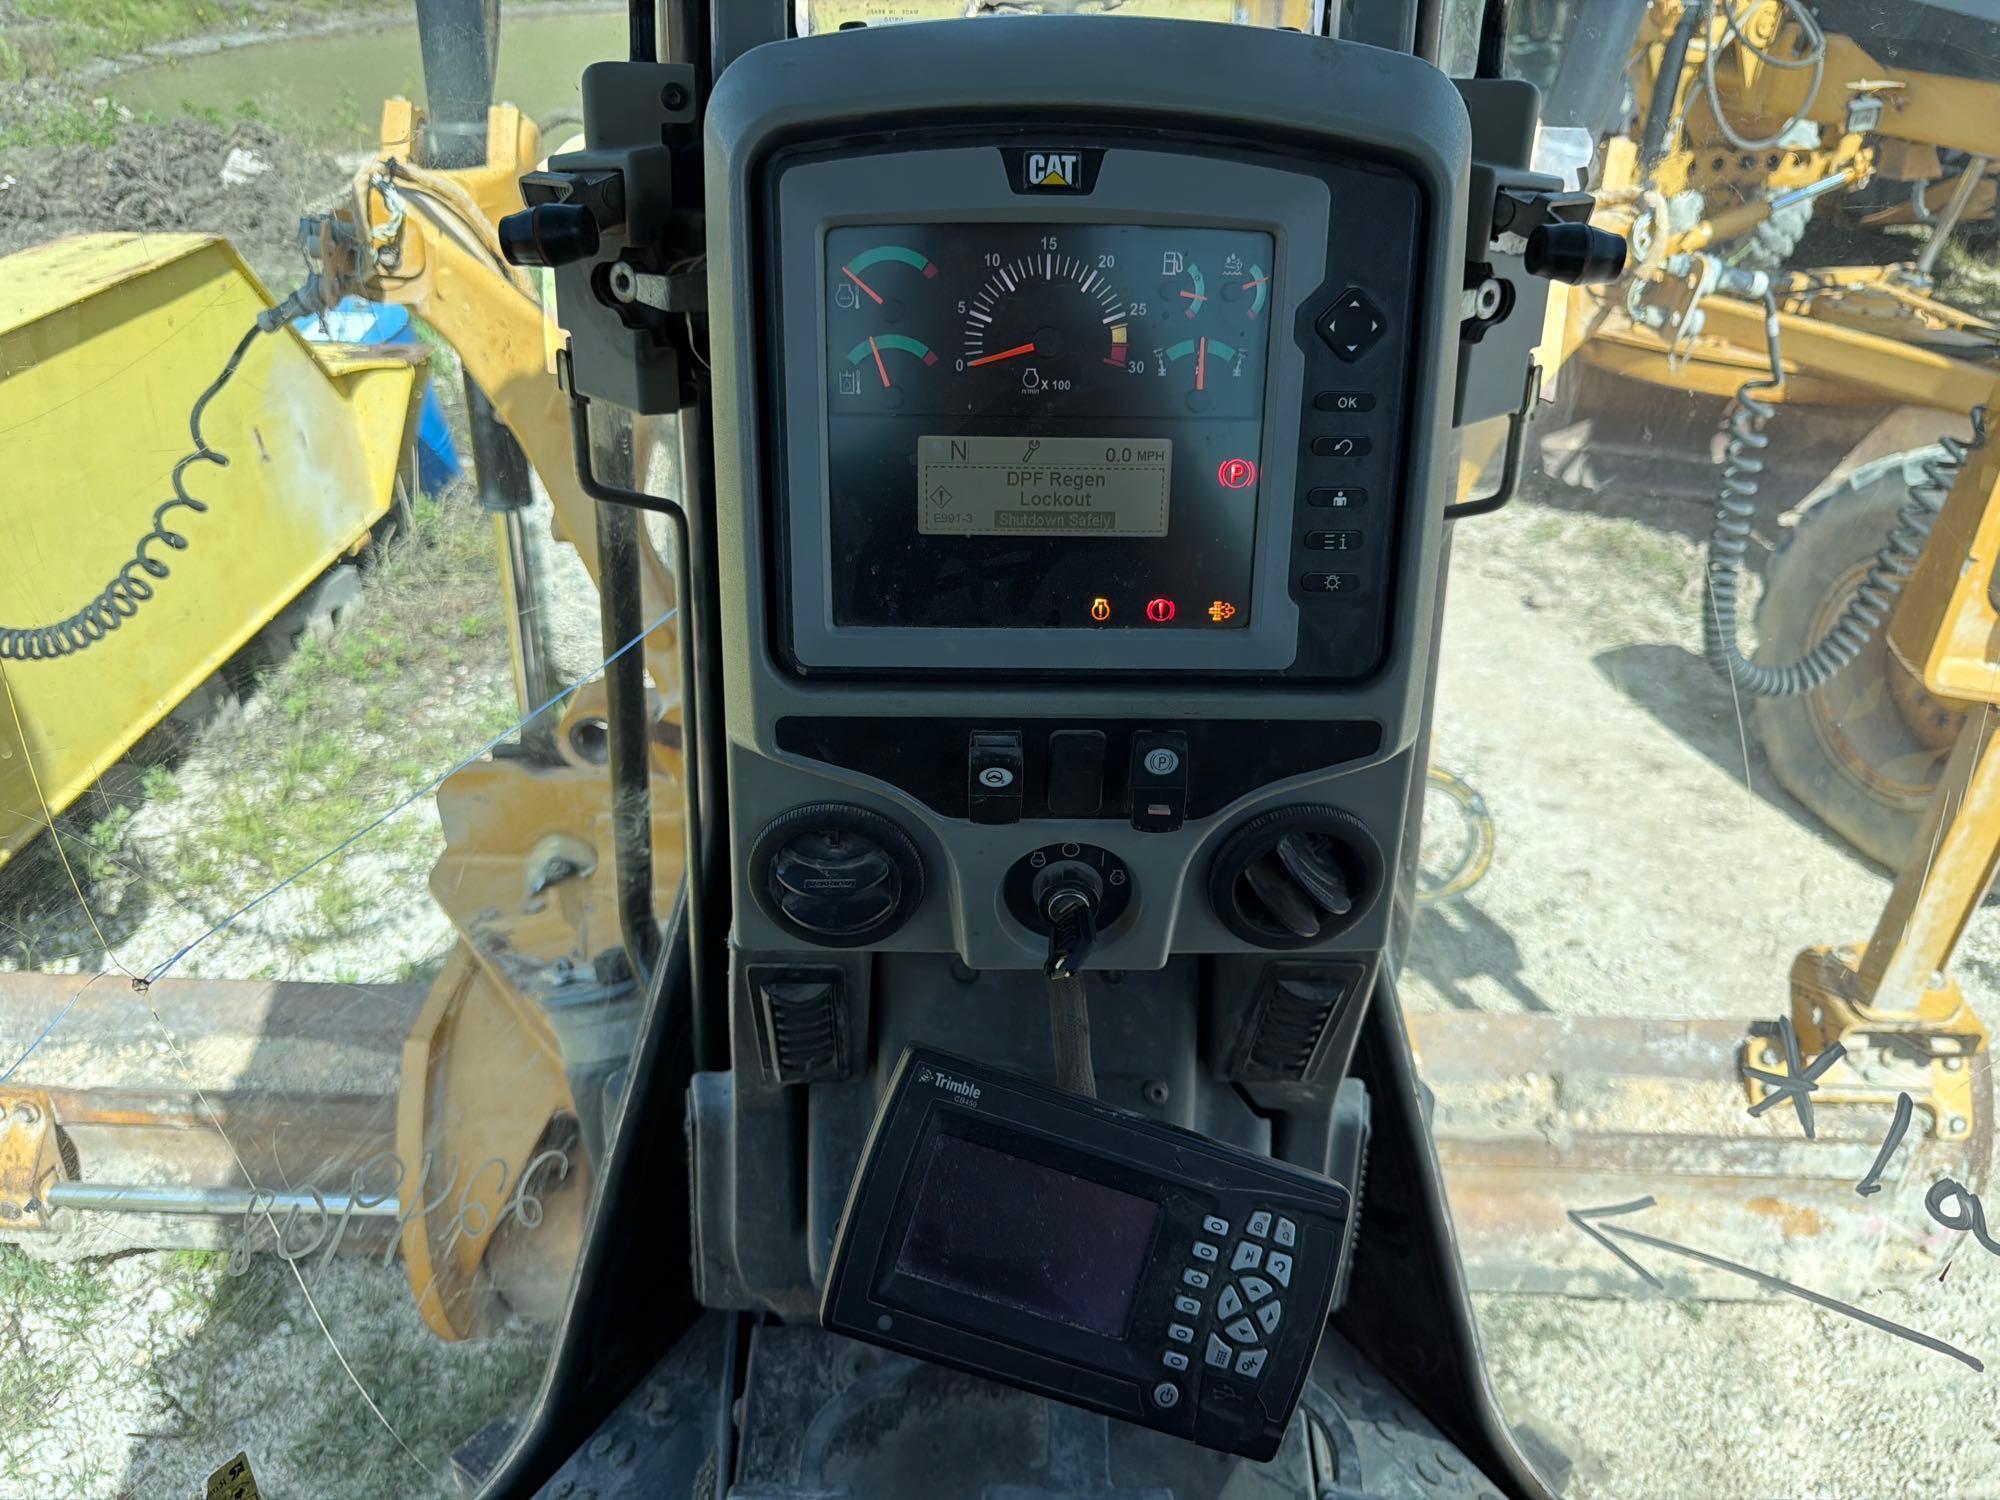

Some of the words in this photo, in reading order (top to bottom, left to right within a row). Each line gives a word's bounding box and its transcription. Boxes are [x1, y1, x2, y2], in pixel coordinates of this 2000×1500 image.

[1029, 154, 1077, 185] CAT
[1041, 237, 1057, 250] 15
[984, 254, 1000, 267] 10
[1098, 255, 1115, 268] 20
[957, 301, 966, 314] 5
[1130, 303, 1147, 316] 25
[955, 359, 964, 372] 0
[1128, 361, 1145, 374] 30
[1052, 380, 1071, 391] 100
[1337, 397, 1358, 409] OK
[951, 440, 967, 461] N
[1105, 447, 1132, 463] 0.0
[1137, 450, 1165, 462] MPH
[1007, 471, 1045, 487] DPF
[1050, 471, 1105, 490] Regen
[1020, 491, 1092, 507] Lockout
[933, 512, 974, 523] E991-3
[1000, 512, 1065, 527] Shutdown
[1070, 513, 1112, 530] Safely
[935, 1072, 981, 1099] Trimble
[1241, 1357, 1258, 1372] OK
